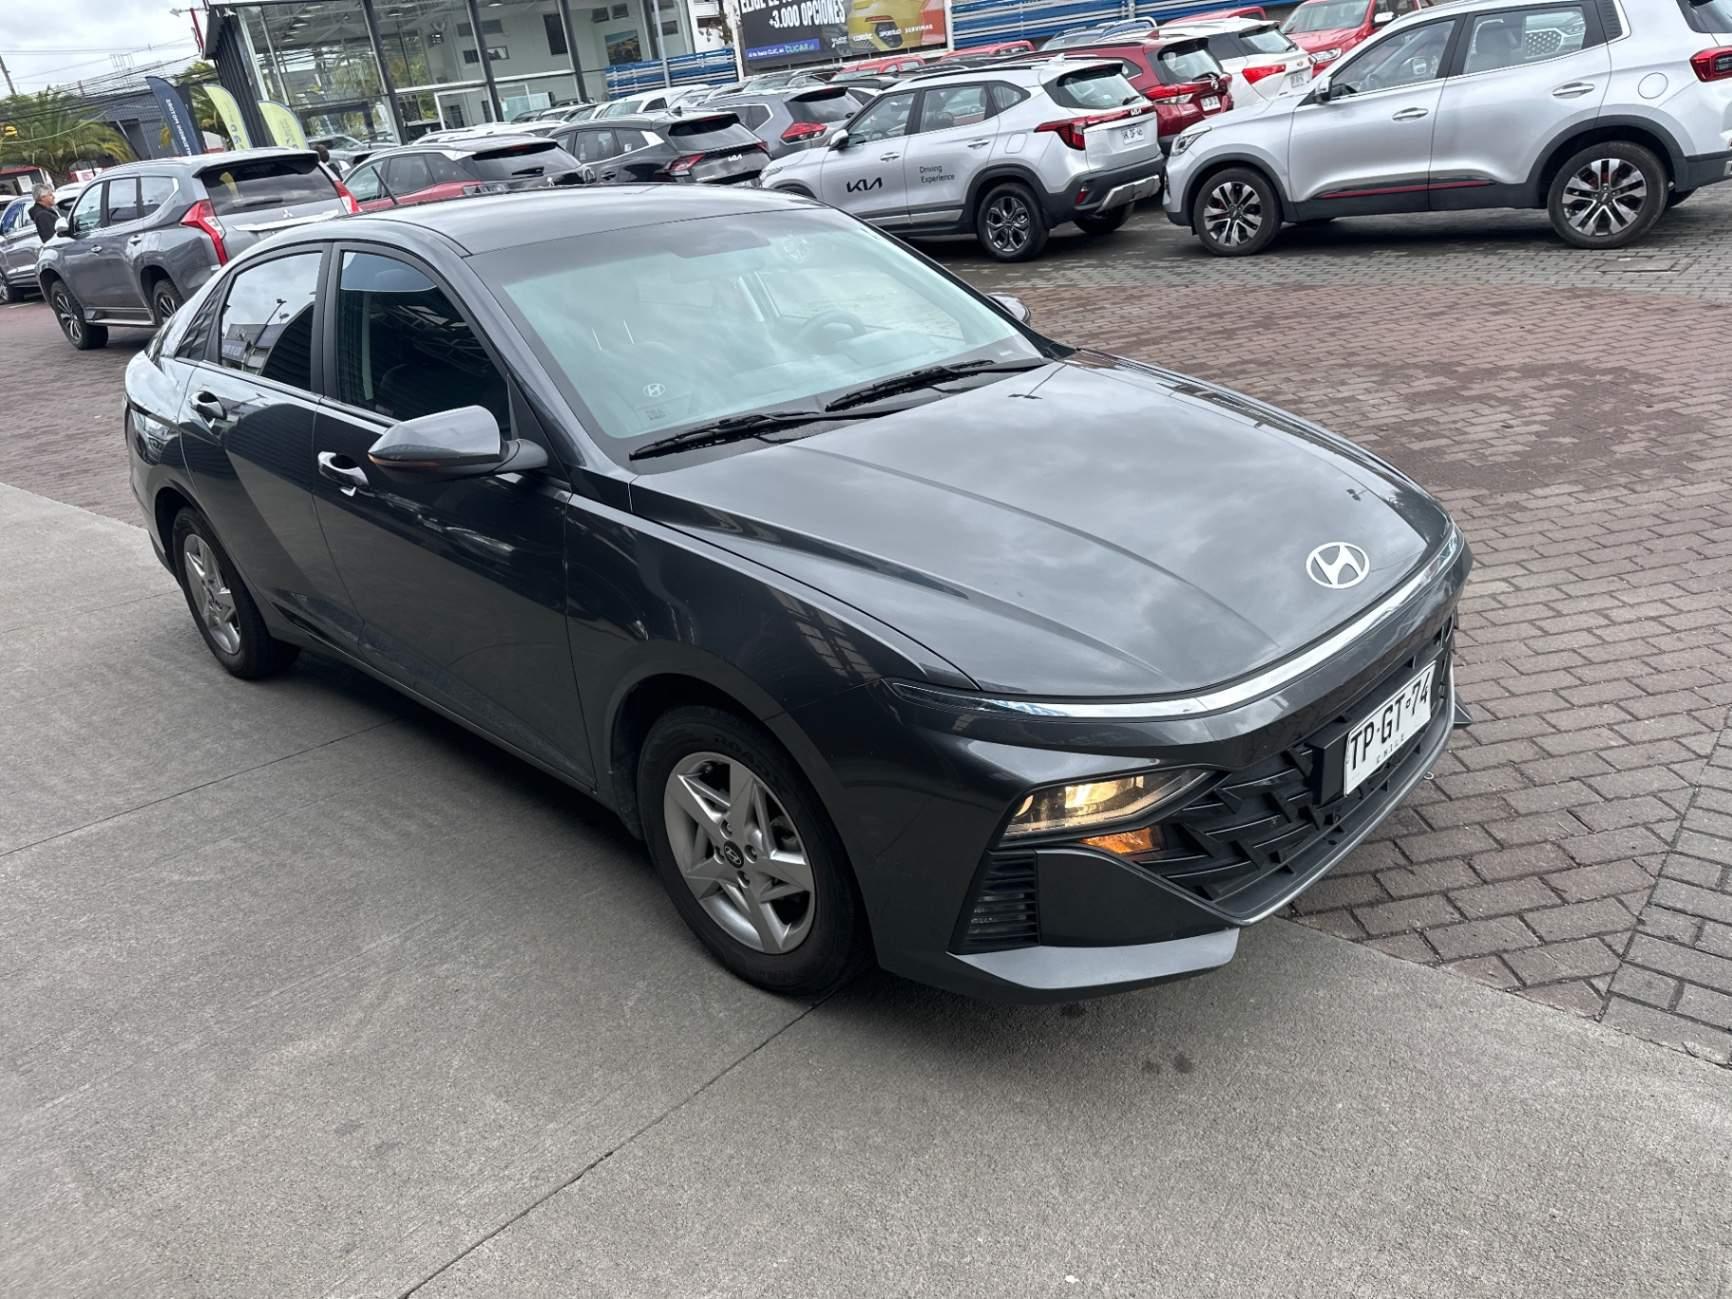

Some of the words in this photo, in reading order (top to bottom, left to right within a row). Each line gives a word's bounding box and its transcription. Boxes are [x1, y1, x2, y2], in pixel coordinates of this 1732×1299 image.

[768, 5, 800, 29] +3.000
[800, 0, 846, 26] OPCIONES
[919, 165, 943, 174] Driving
[846, 177, 883, 193] KIA
[920, 174, 955, 184] Experience
